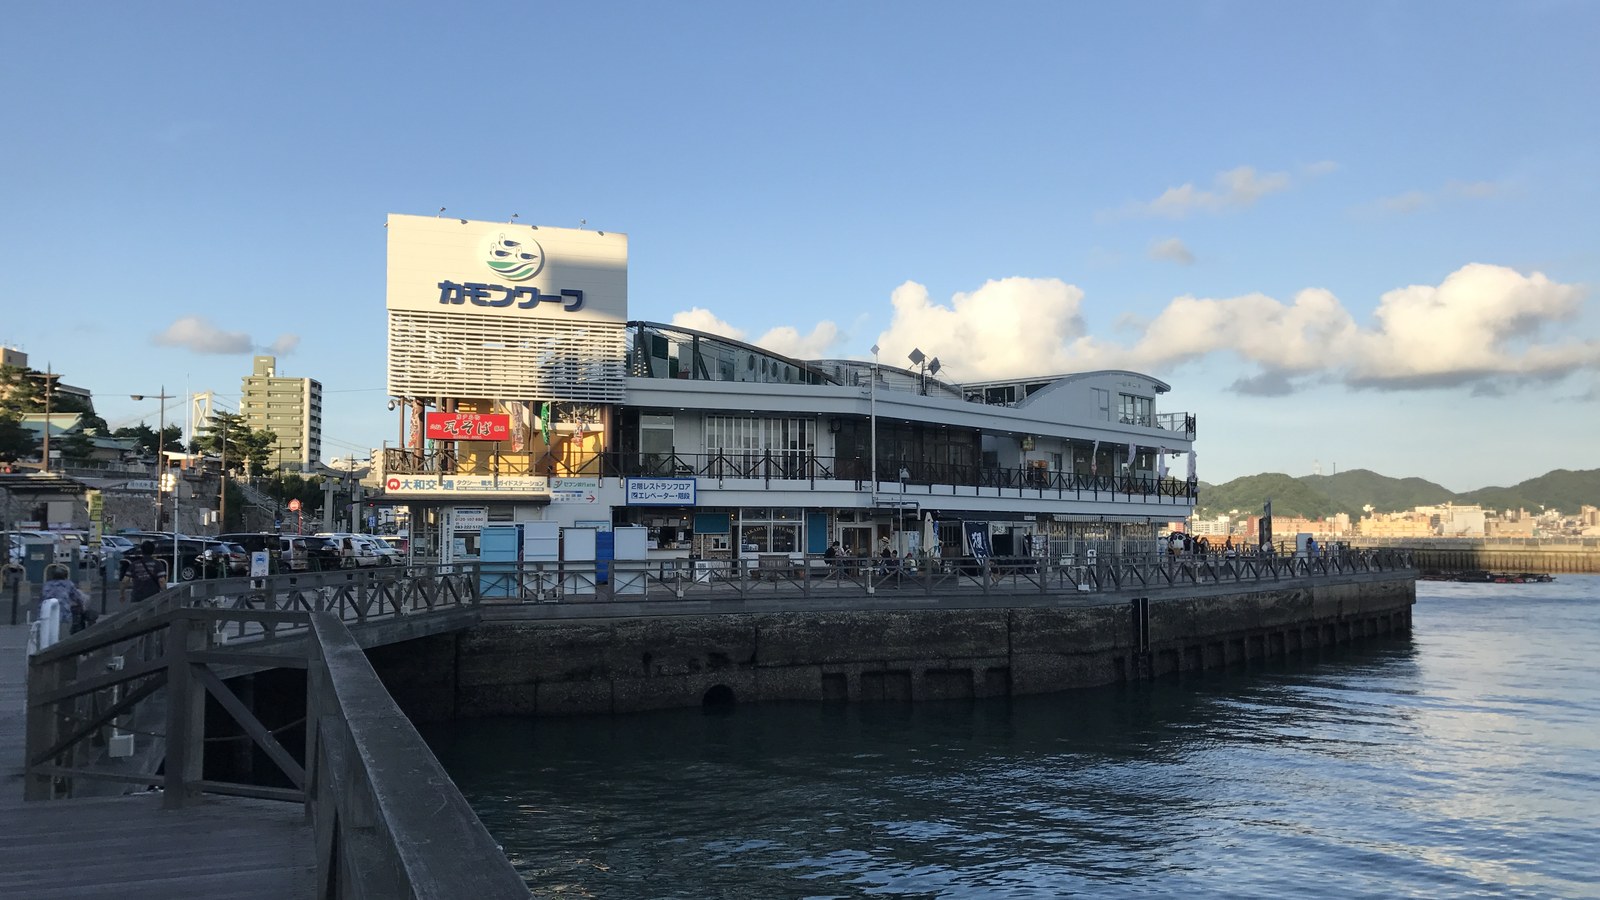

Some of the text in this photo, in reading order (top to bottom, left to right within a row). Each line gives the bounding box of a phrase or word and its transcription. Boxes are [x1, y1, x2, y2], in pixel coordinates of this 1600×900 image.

[437, 279, 584, 312] カモンワーフ
[443, 419, 493, 436] 瓦そば
[401, 479, 454, 490] 大和交通
[631, 482, 691, 490] 2階レストランフロア
[638, 492, 690, 500] エレベーター・階段
